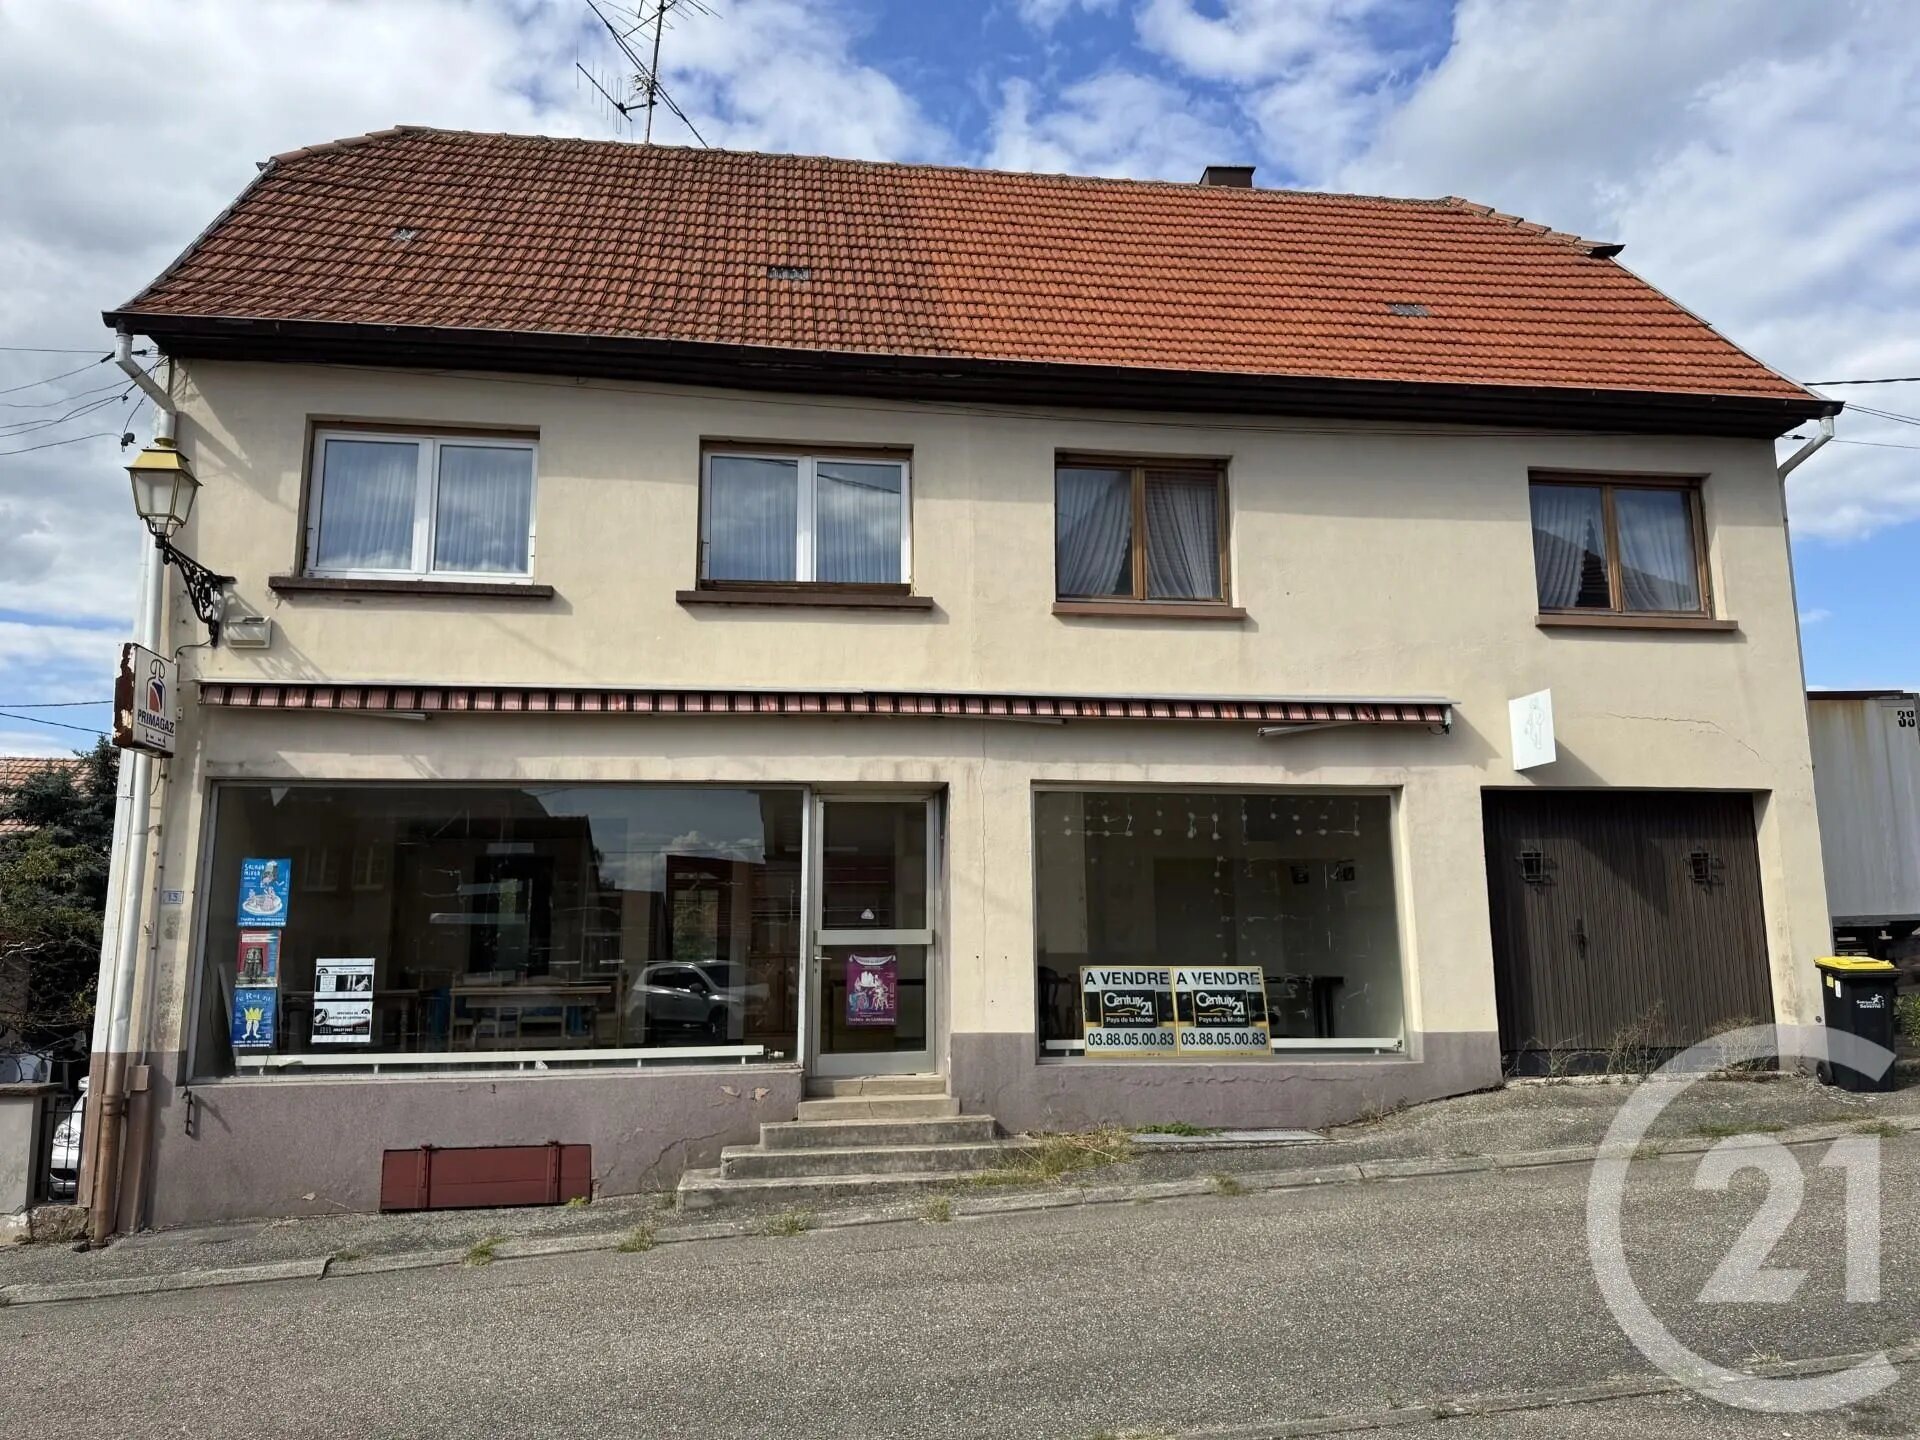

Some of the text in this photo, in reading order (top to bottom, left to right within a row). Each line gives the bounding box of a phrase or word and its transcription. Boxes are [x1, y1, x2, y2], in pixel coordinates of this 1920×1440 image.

[137, 708, 175, 734] PRIMAGAZ
[1085, 972, 1170, 985] A VENDRE
[1176, 972, 1261, 985] A VENDRE
[1104, 992, 1153, 1016] Century 21
[1196, 992, 1245, 1016] Century 21
[1106, 1016, 1120, 1024] Pays
[1198, 1016, 1213, 1024] Pays
[1088, 1033, 1174, 1046] 03.88.05.00.83
[1181, 1032, 1266, 1046] 03.88.05.00.83
